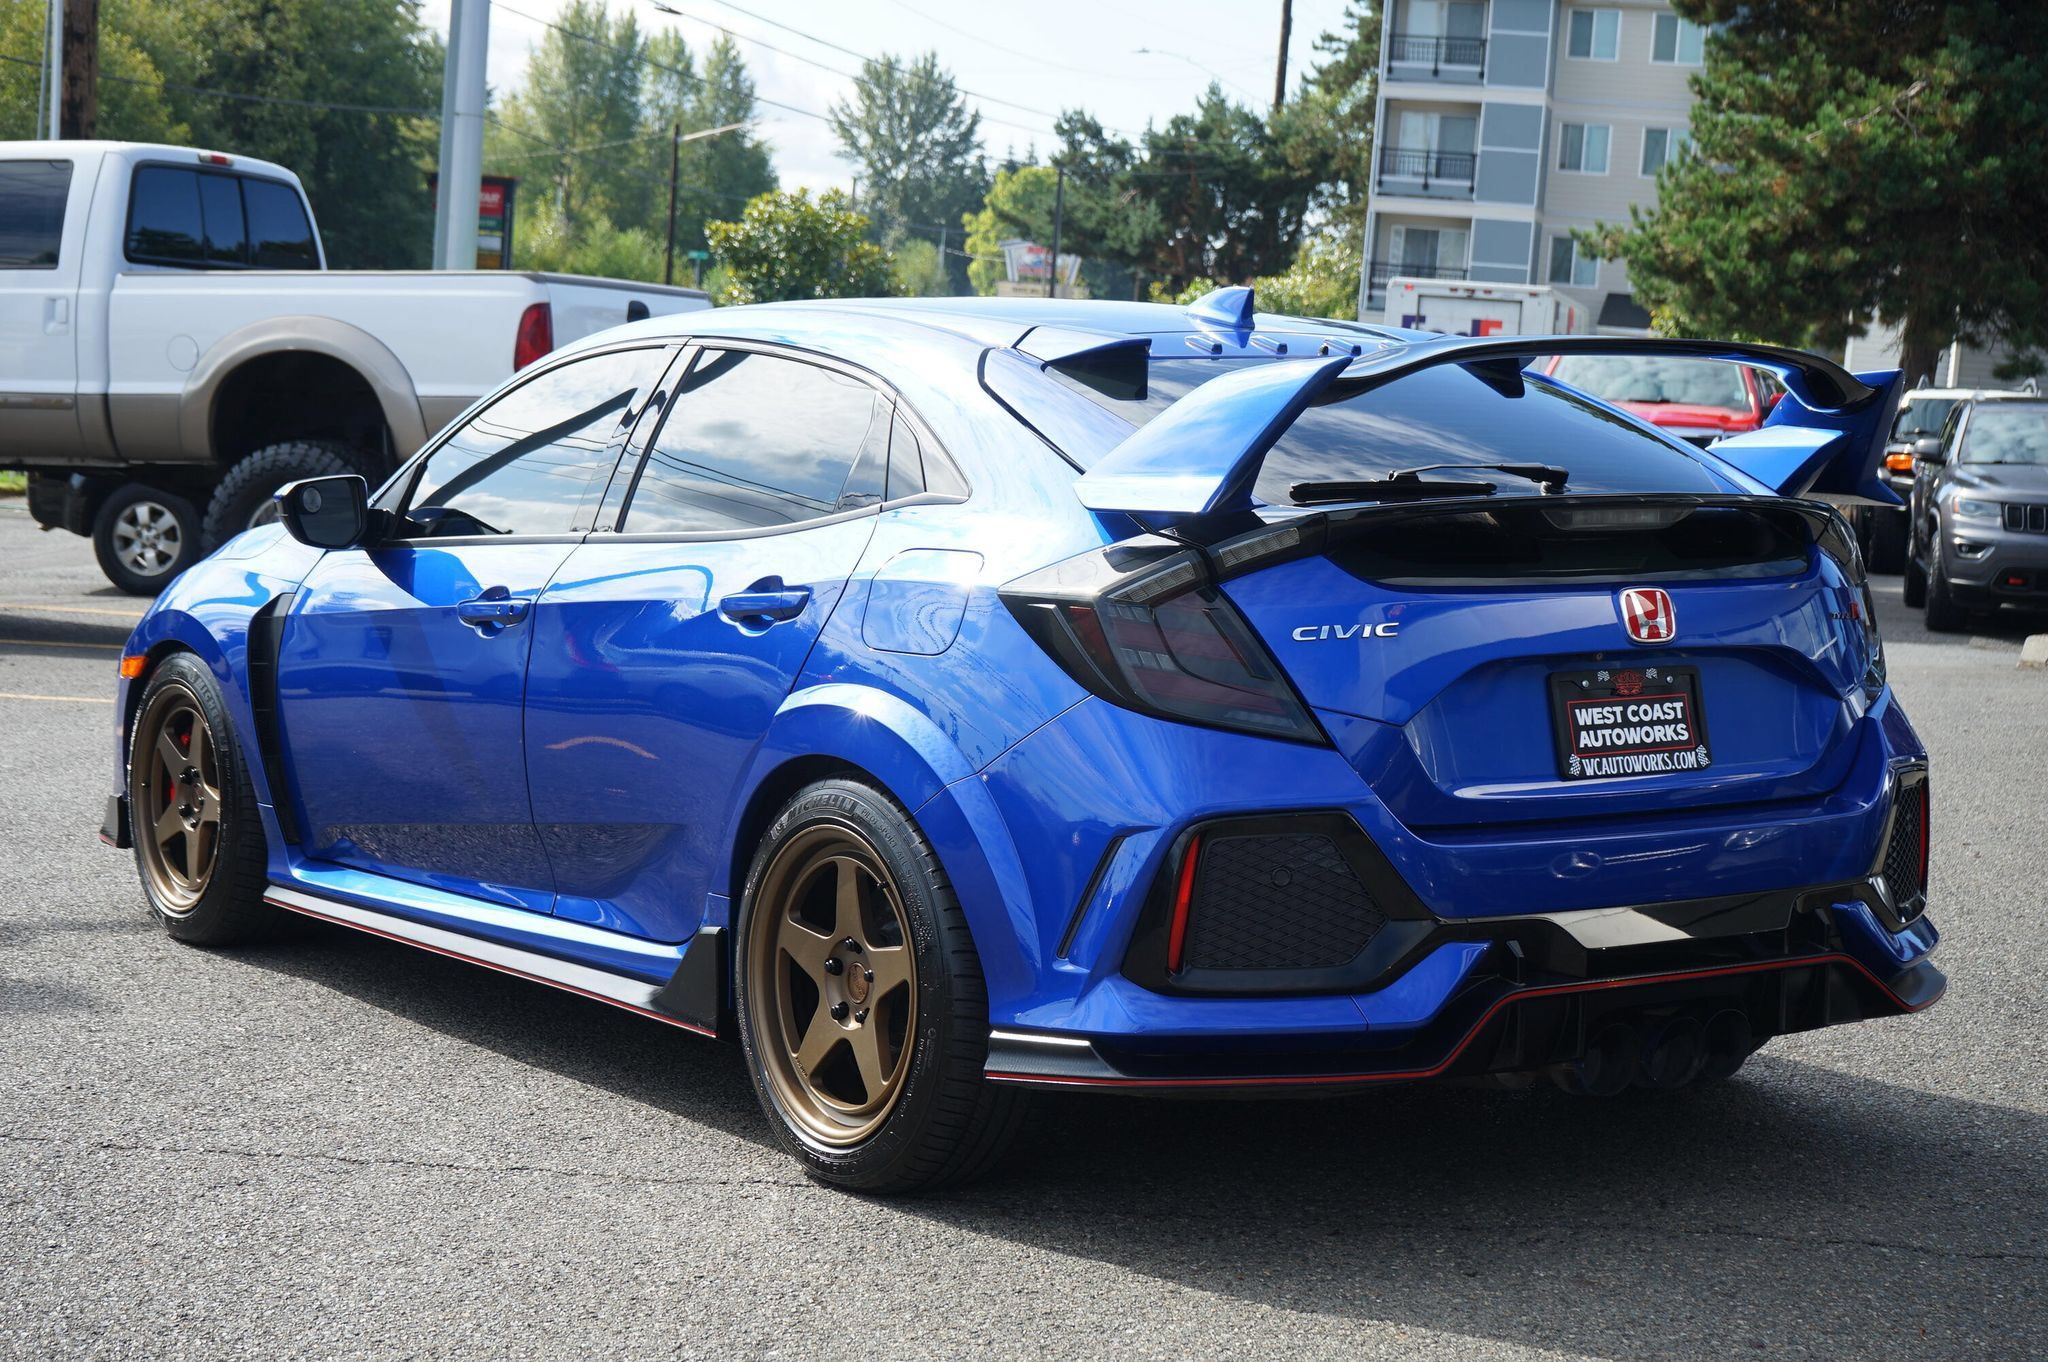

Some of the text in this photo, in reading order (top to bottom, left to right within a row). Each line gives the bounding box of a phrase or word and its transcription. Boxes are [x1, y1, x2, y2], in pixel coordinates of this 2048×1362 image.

[1292, 622, 1400, 641] CIVIC
[1575, 702, 1684, 726] WEST COAST
[1579, 724, 1689, 748] AUTOWORKS
[1582, 751, 1698, 776] WCAUTOWORKS.COM
[786, 794, 856, 822] MICHELIN
